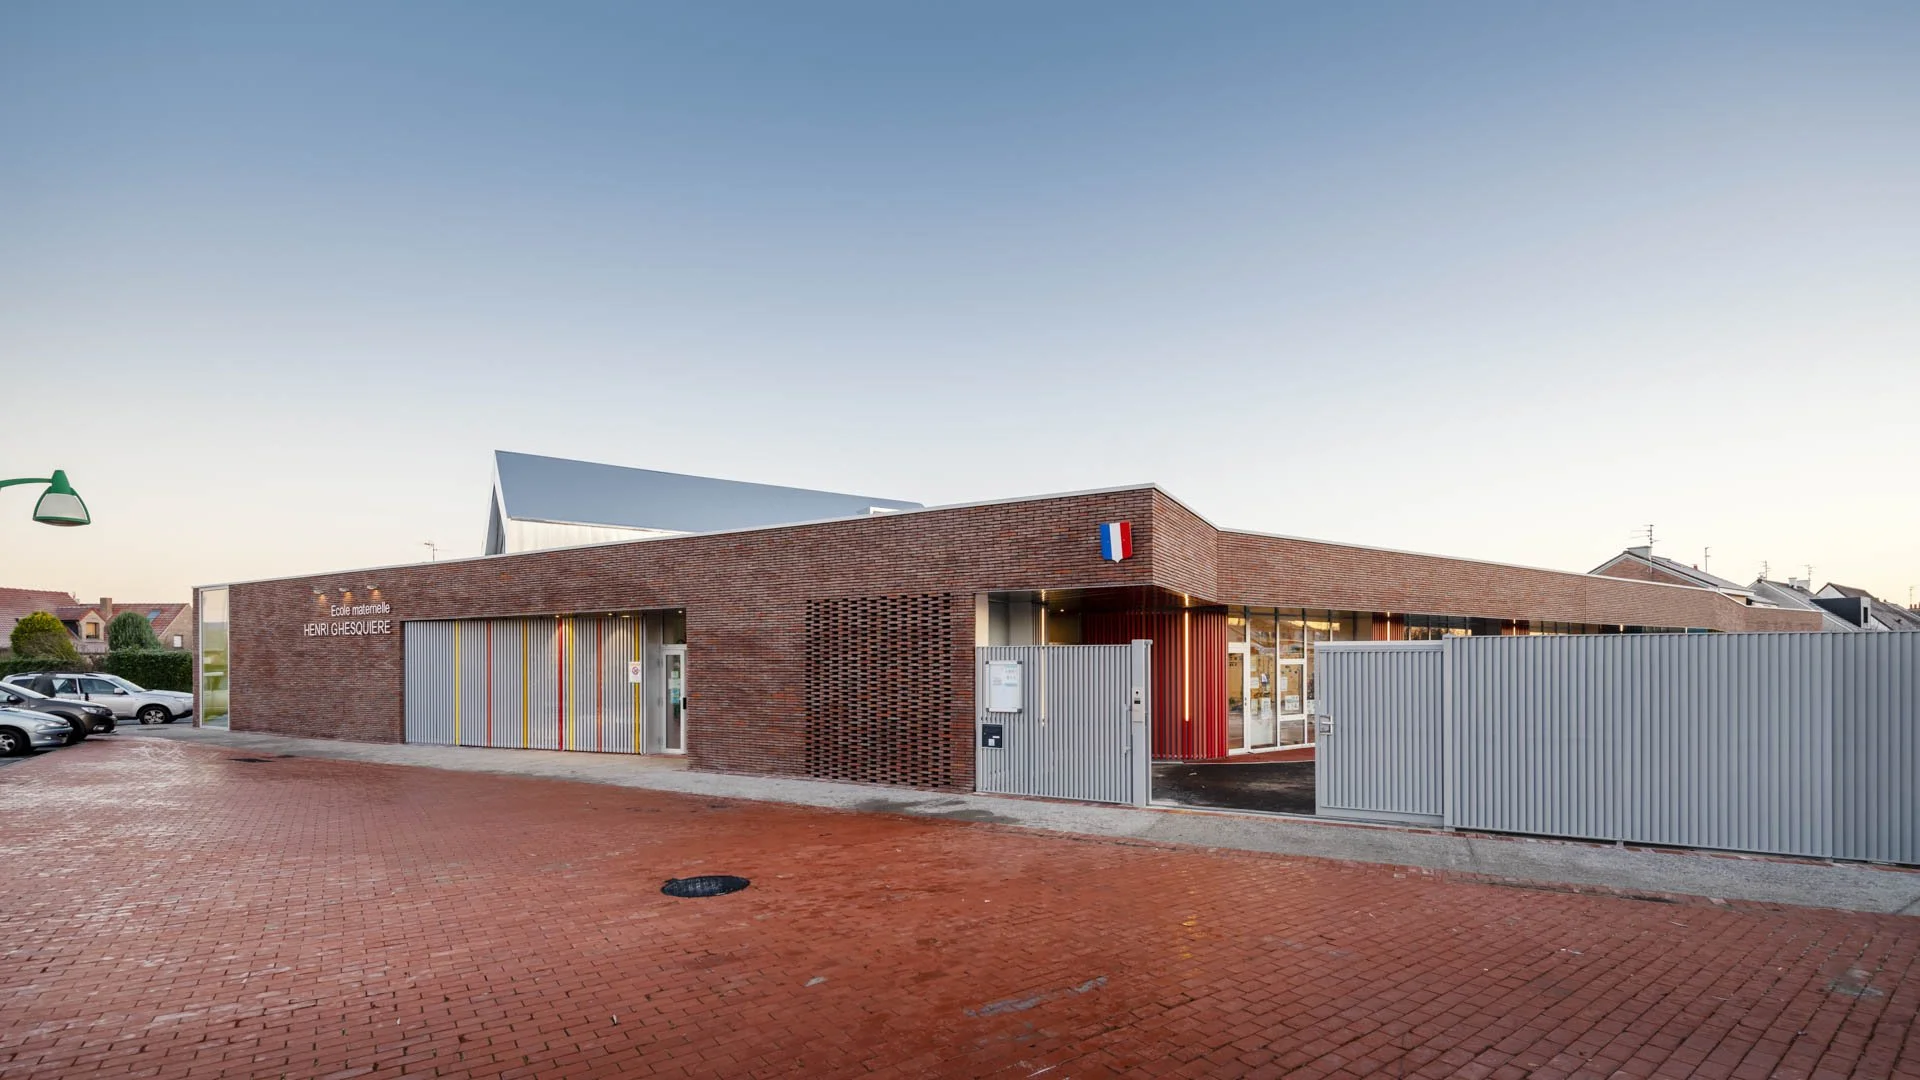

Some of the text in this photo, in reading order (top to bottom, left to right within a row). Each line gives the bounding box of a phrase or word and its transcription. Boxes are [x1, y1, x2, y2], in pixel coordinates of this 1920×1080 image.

[331, 601, 390, 617] Ecole maternelle
[304, 620, 391, 636] HENRI GHESQUIERE
